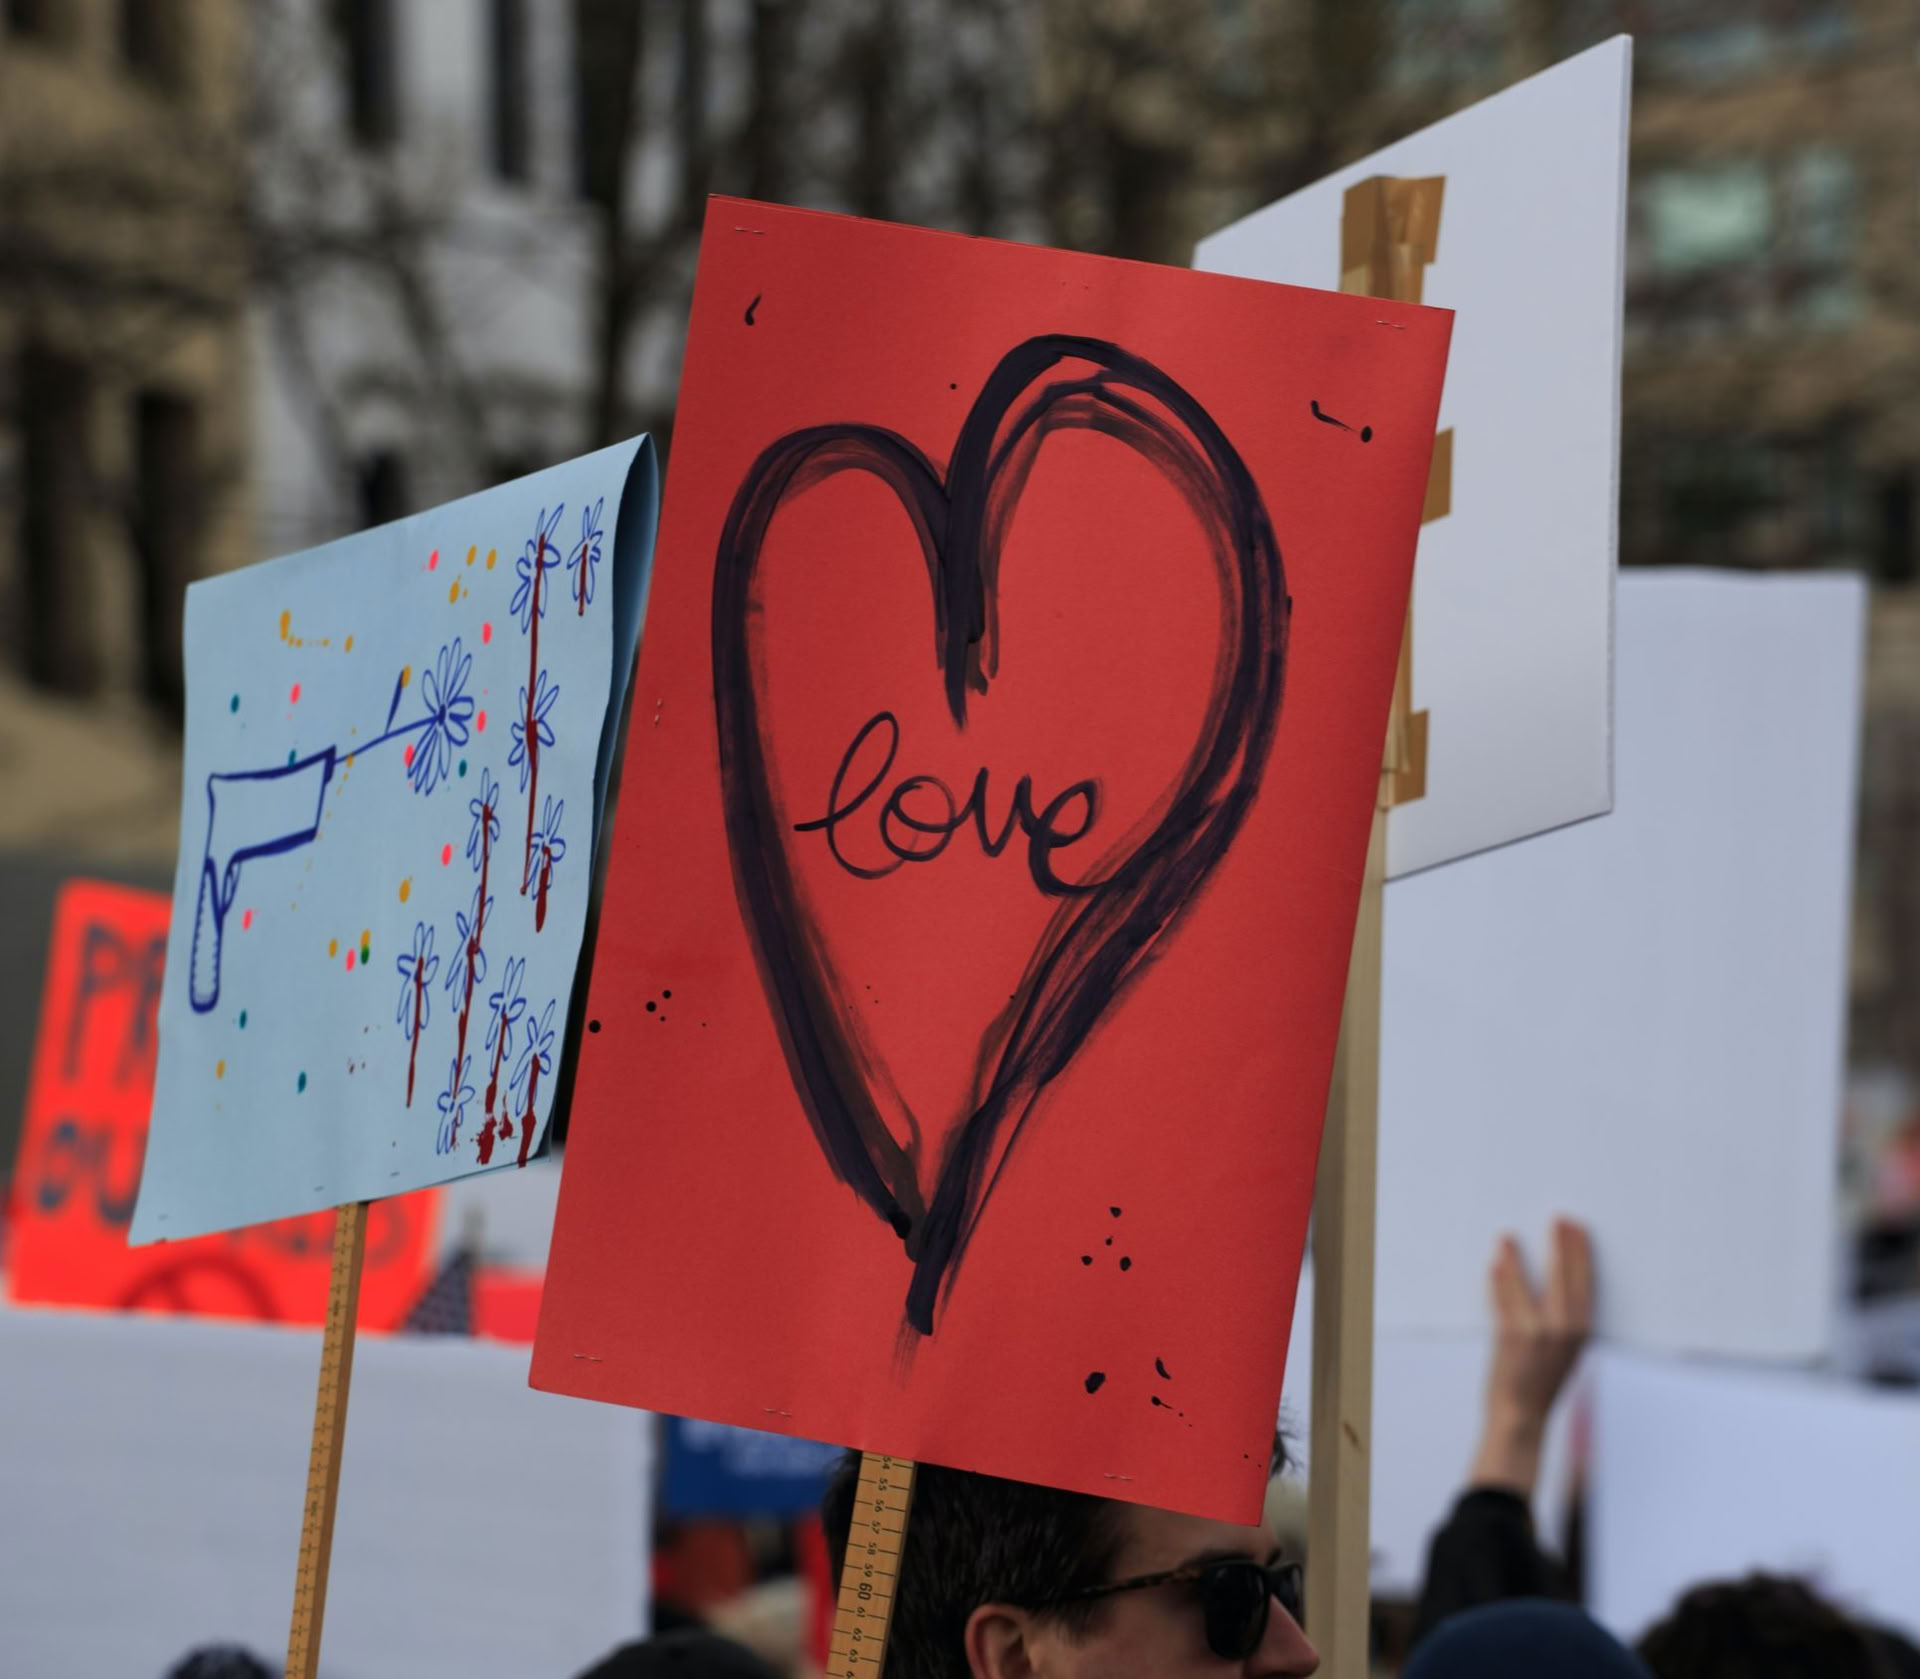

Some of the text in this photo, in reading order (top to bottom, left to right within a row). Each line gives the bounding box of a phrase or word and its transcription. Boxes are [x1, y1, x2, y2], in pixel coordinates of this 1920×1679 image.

[794, 711, 1110, 896] love
[881, 1456, 892, 1470] 54
[878, 1478, 888, 1491] 55
[874, 1499, 885, 1512] 56
[871, 1520, 881, 1534] 57
[866, 1541, 877, 1555] 58
[863, 1562, 874, 1577] 59
[857, 1582, 872, 1601] 60
[856, 1606, 866, 1618] 61
[851, 1627, 862, 1642] 62
[848, 1648, 858, 1663] 63
